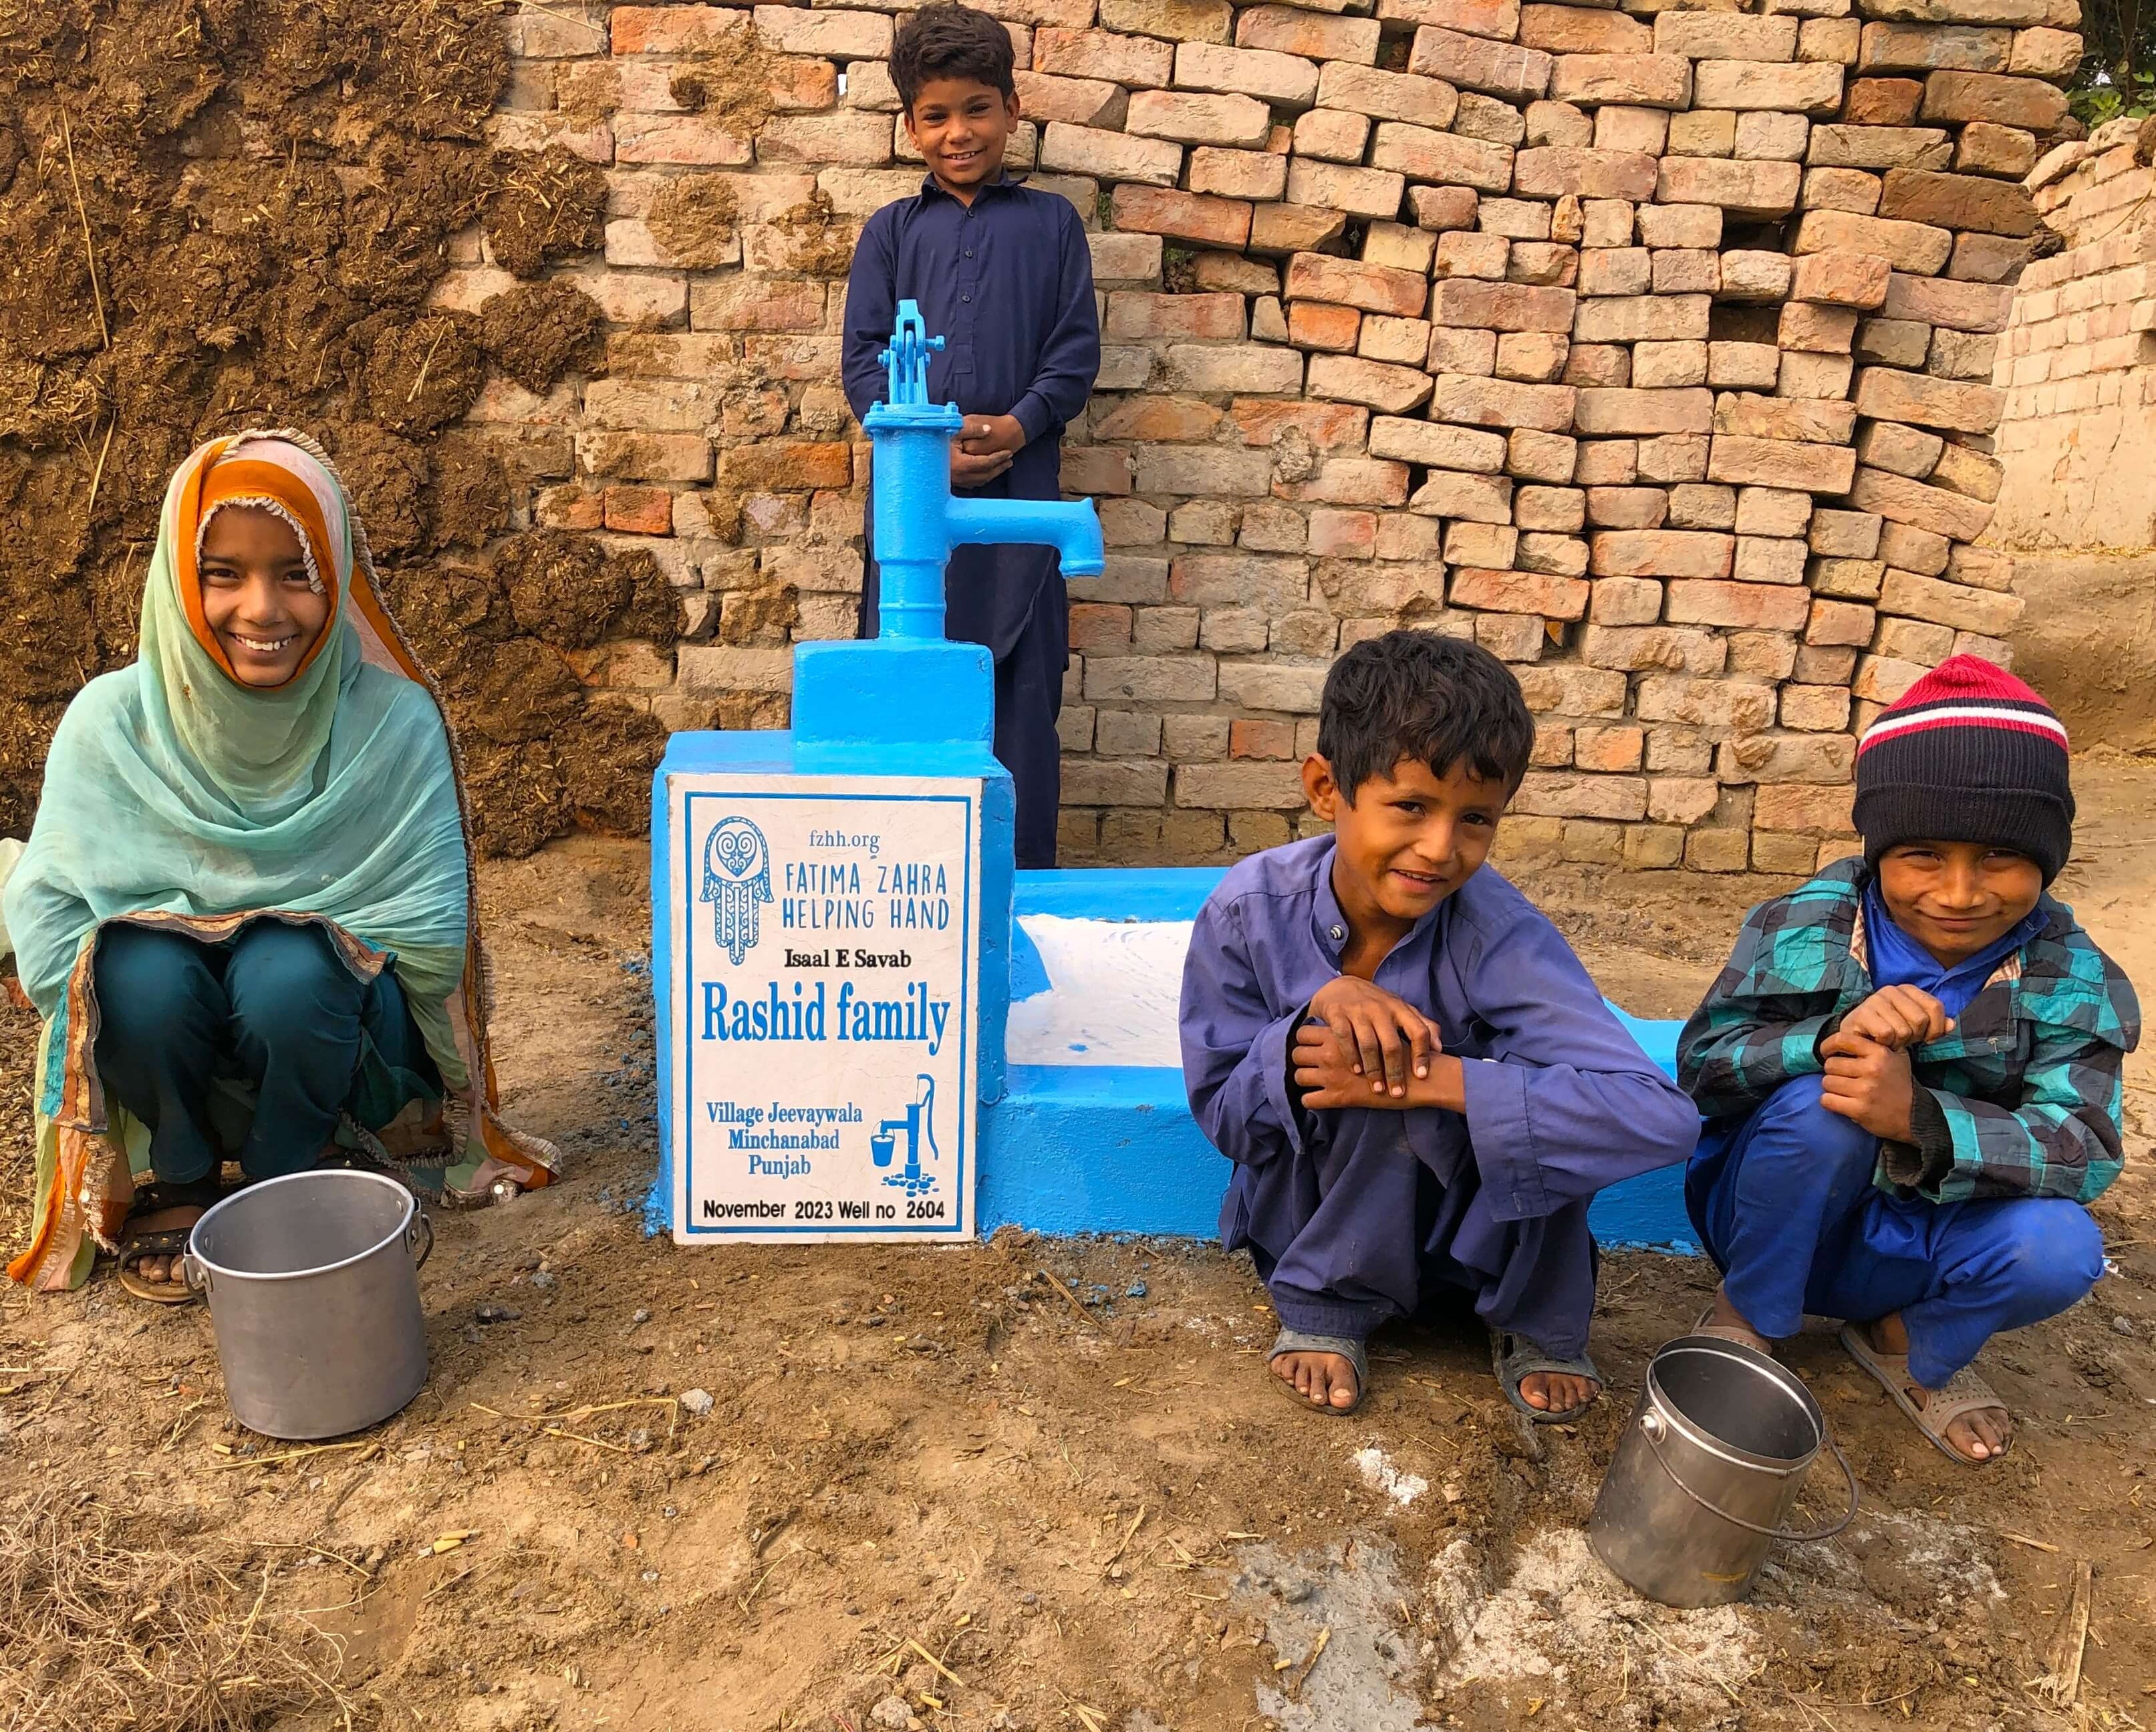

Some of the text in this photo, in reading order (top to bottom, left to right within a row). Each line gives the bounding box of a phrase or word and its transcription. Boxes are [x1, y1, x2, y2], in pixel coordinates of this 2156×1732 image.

[809, 829, 881, 854] fzhh.org
[785, 861, 947, 896] FATIMA ZAHRA
[782, 897, 950, 931] HELPING HAND
[784, 948, 912, 968] Isaal E Savab
[701, 981, 951, 1056] Rashid family
[706, 1101, 863, 1127] Village Jeevaywala
[728, 1128, 840, 1149] Minchanabad
[748, 1154, 811, 1178] Punjab
[703, 1199, 945, 1219] November 2023 Well no 2604
